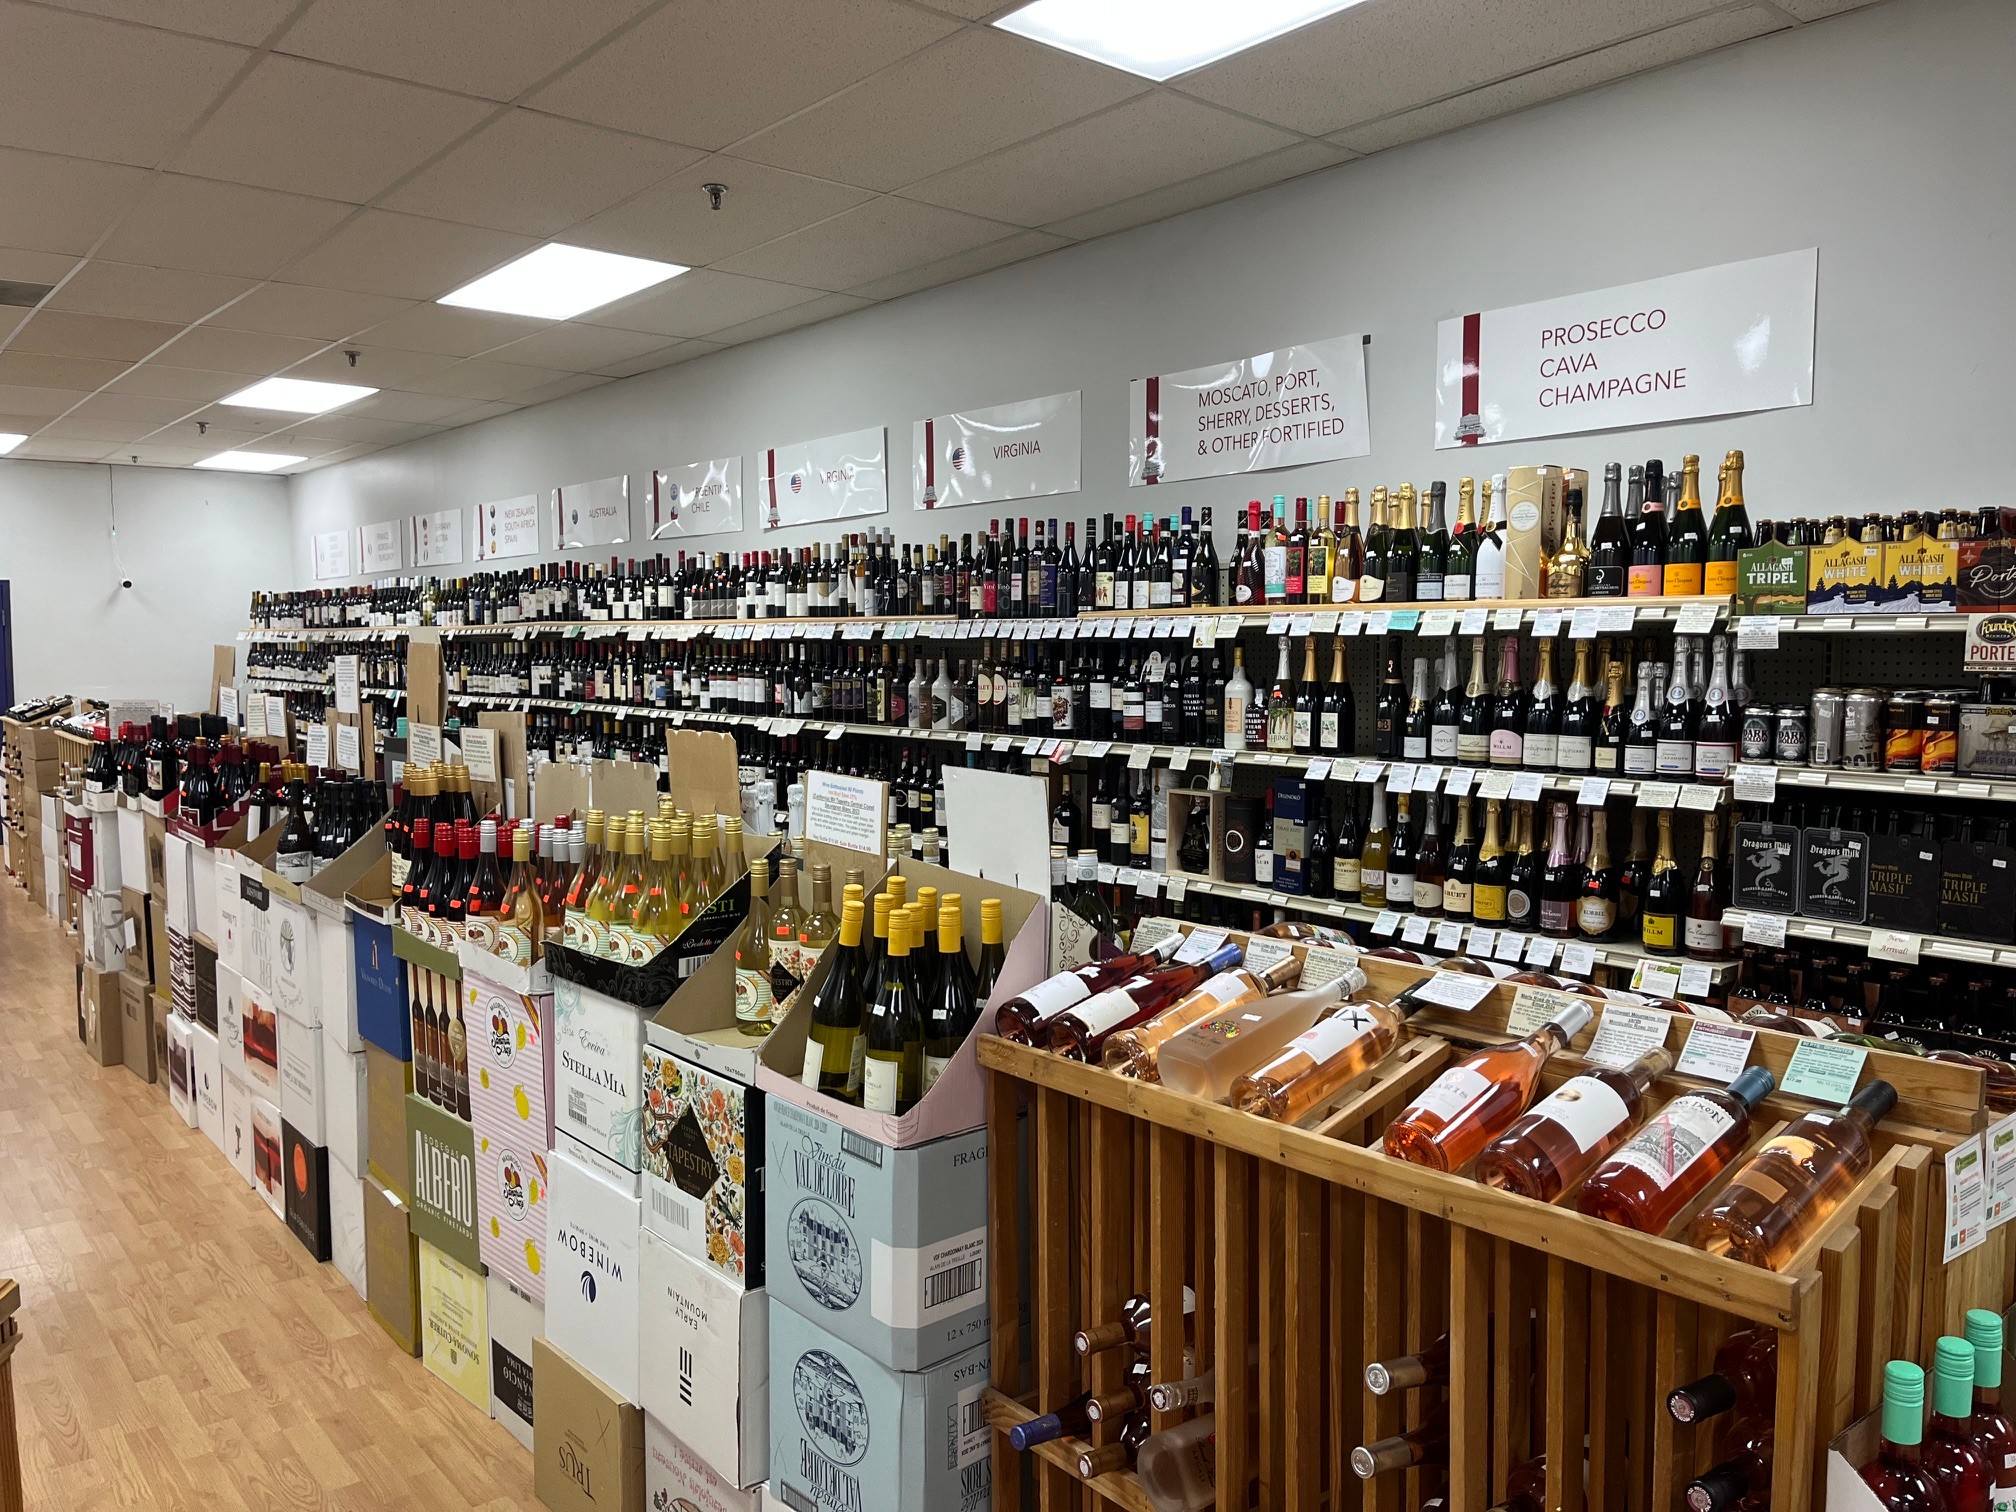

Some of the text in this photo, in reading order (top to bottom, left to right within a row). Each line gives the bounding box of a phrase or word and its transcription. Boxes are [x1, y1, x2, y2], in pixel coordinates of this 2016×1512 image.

[1541, 309, 1667, 349] PROSECCO
[1540, 352, 1598, 378] CAVA
[1198, 369, 1320, 407] MOSCATO, PORT,
[1539, 368, 1687, 409] CHAMPAGNE
[1198, 393, 1335, 432] SHERRY, DESSERTS,
[1198, 417, 1345, 456] & OTHER FORTIFIED
[993, 440, 1041, 460] VIRGINIA
[504, 505, 535, 519] NEW ZEALAND
[588, 506, 617, 519] AUSTRALIA
[691, 501, 710, 514] CHILE
[504, 519, 536, 532] SOUTH AFRICA
[504, 533, 518, 543] SPAIN
[1824, 556, 1867, 567] ALLAGASH
[1899, 553, 1945, 564] ALLAGASH
[1750, 562, 1793, 573] ALLAGASH
[1823, 566, 1867, 579] WHITE
[1899, 564, 1944, 577] WHITE
[1746, 571, 1797, 585] TRIPEL
[1743, 727, 1769, 740] DARK
[1778, 730, 1805, 742] DARK
[1742, 838, 1792, 851] Dragon's Milk
[1809, 844, 1860, 859] Dragon's Milk
[1869, 870, 1913, 885] TRIPLE
[1869, 880, 1905, 894] MASH
[1942, 878, 1988, 894] TRIPLE
[1941, 889, 1979, 904] MASH
[1583, 909, 1605, 917] KORBEL
[562, 1049, 627, 1098] STELLA MIA
[424, 1133, 460, 1158] BODEGAS
[667, 1141, 714, 1180] TAPESTRY
[415, 1129, 473, 1228] ALBERO
[794, 1150, 812, 1190] VAL
[826, 1165, 856, 1219] LOIRE
[416, 1199, 473, 1241] ORGANIC VINEYARDS
[588, 1232, 599, 1244] WINE
[600, 1242, 609, 1250] FINE
[557, 1229, 623, 1282] WINEBOW
[667, 1286, 708, 1322] MOUNTAIN
[674, 1306, 698, 1331] EARLY
[947, 1320, 982, 1342] 12 x 750
[428, 1317, 480, 1366] SONOMA-CUTRER
[558, 1441, 598, 1505] TRUS
